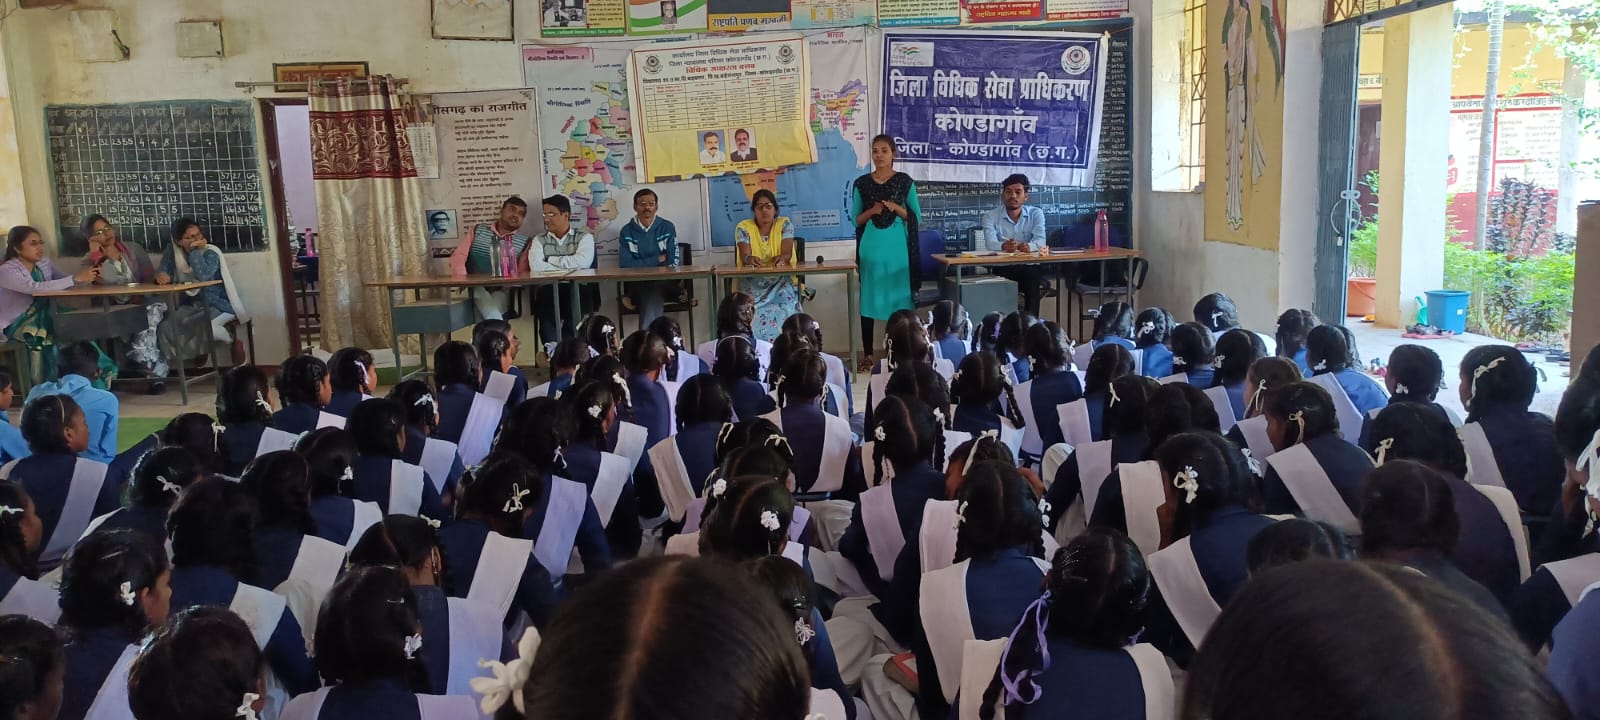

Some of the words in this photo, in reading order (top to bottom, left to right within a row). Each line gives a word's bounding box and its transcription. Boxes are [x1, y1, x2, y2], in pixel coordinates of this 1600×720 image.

[890, 69, 928, 97] जिला
[934, 69, 980, 98] विधिक
[984, 71, 1014, 100] सेवा
[1020, 72, 1090, 101] प्राधिकरण
[470, 104, 484, 113] का
[488, 101, 527, 112] राजगीत
[934, 106, 1038, 134] कोण्डागाँव
[894, 137, 929, 156] जिला
[948, 138, 1022, 158] कोण्डागाँव
